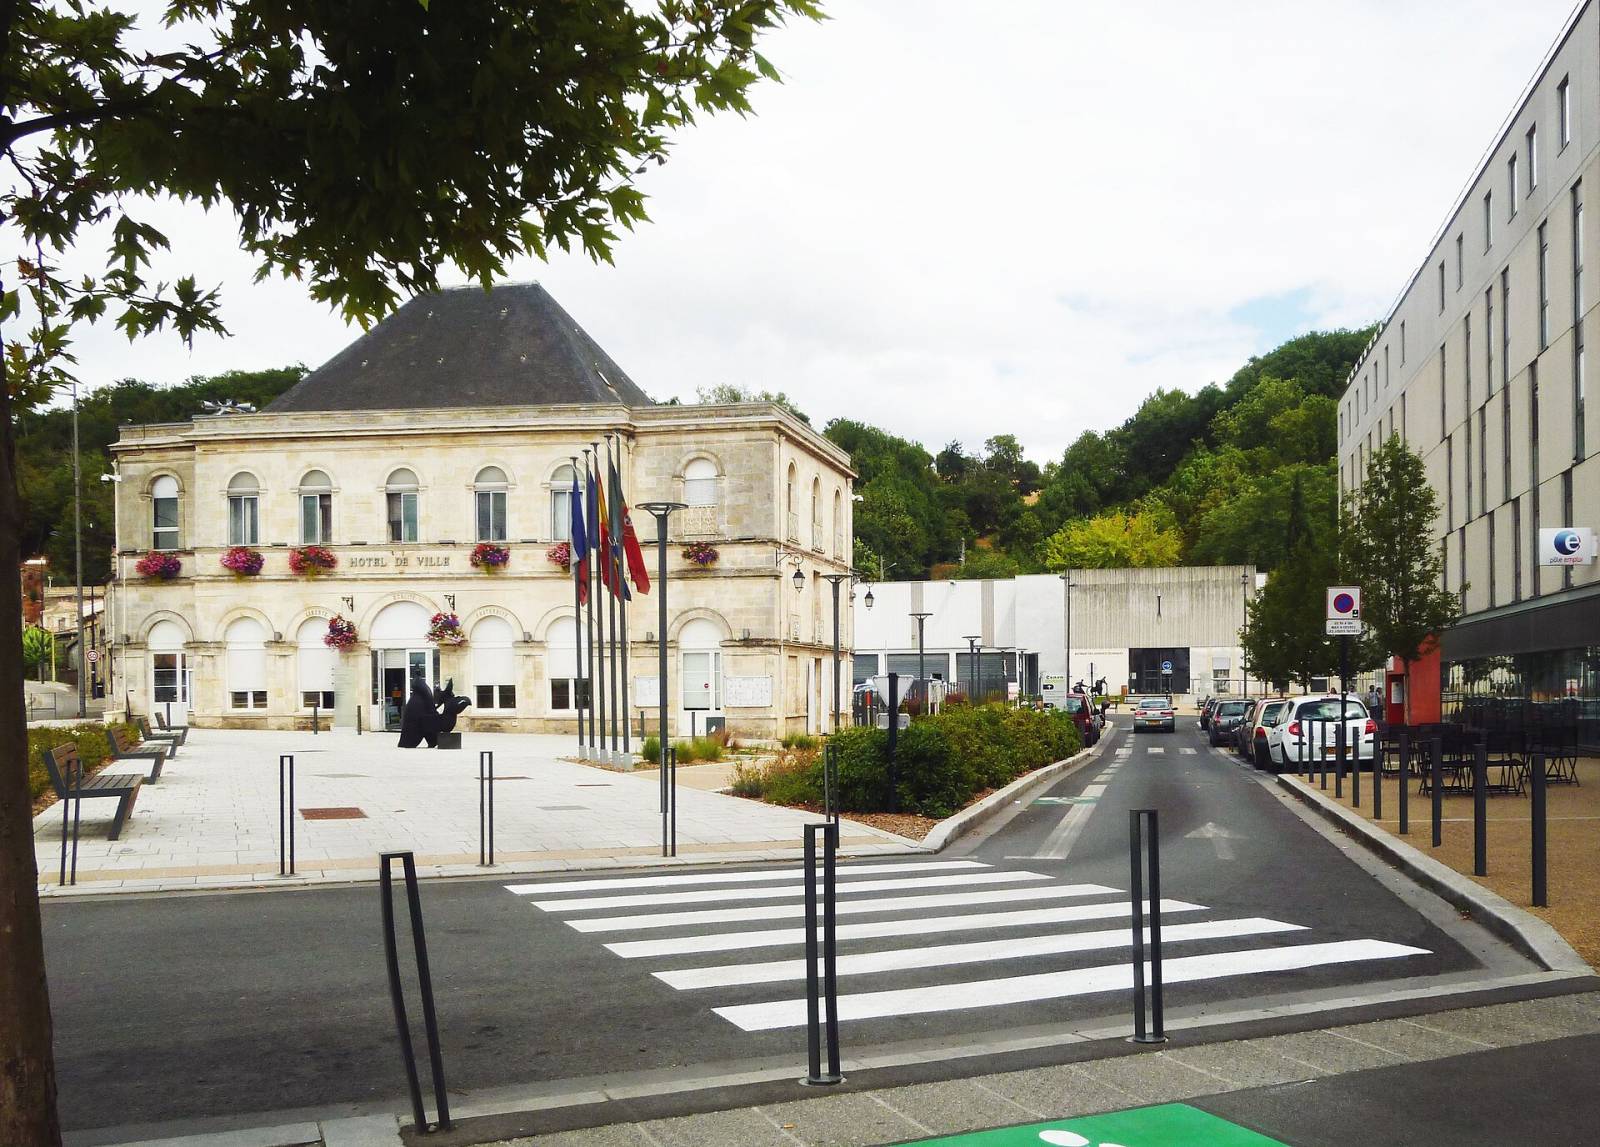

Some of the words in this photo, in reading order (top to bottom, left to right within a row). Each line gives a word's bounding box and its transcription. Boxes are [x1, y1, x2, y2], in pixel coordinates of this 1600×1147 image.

[350, 556, 387, 567] HOTEL
[395, 556, 408, 566] DE
[417, 556, 450, 566] VILLE
